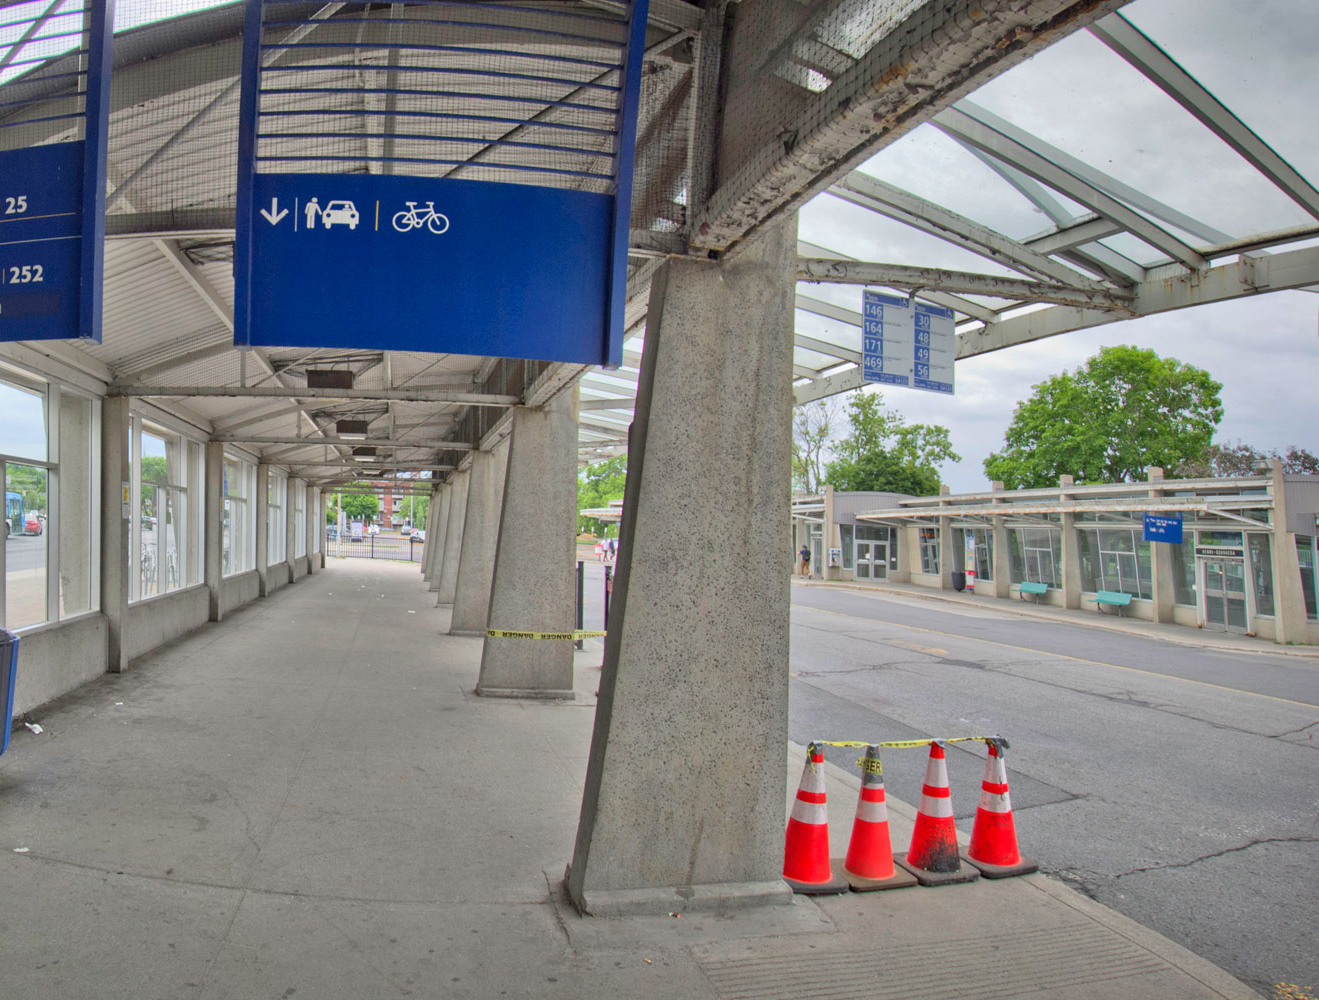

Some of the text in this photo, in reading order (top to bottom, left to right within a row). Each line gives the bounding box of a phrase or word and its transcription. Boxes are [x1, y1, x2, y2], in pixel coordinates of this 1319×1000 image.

[5, 195, 27, 215] 25
[9, 265, 43, 284] 252
[865, 304, 883, 317] 146
[919, 315, 930, 327] 30
[865, 321, 882, 335] 164
[918, 332, 929, 343] 48
[865, 338, 881, 351] 171
[918, 348, 929, 360] 49
[864, 356, 882, 369] 469
[917, 365, 928, 376] 56
[502, 631, 534, 639] DANGER
